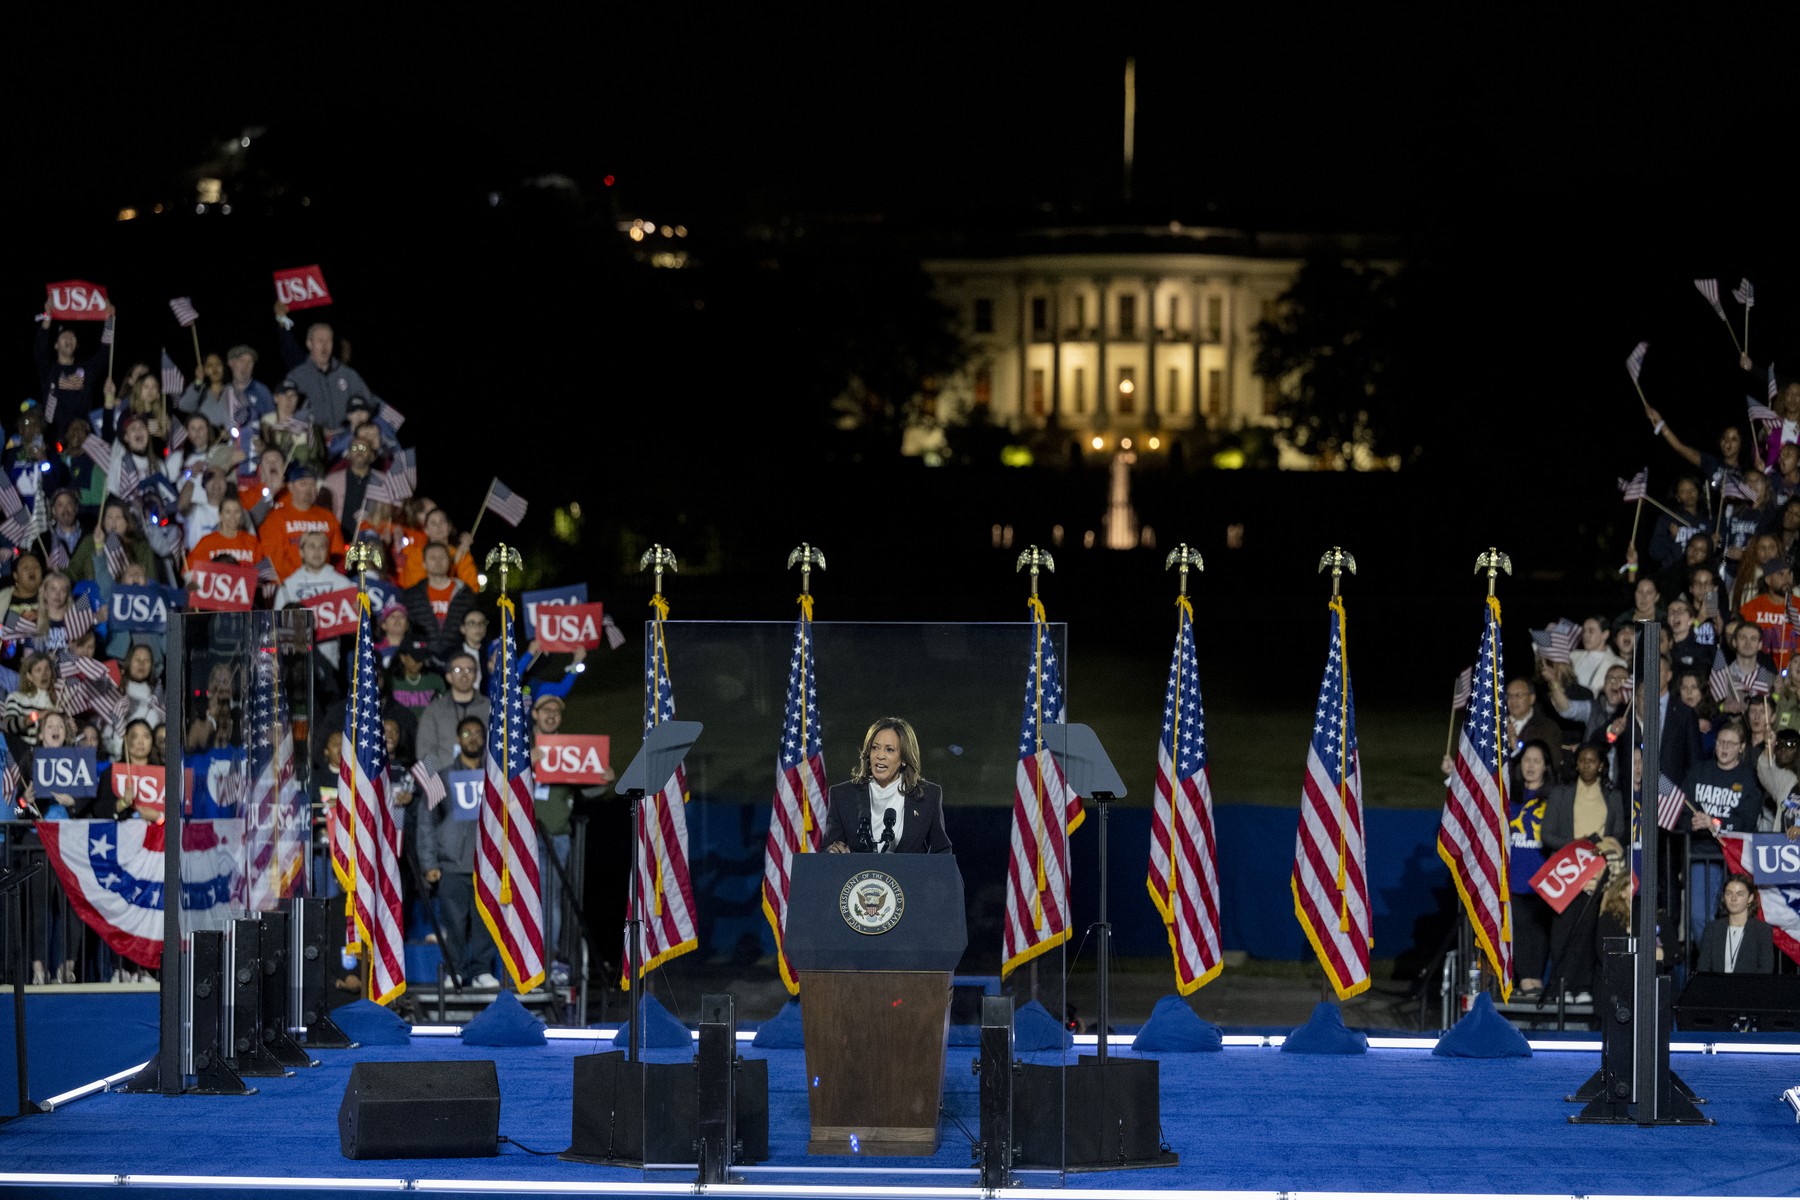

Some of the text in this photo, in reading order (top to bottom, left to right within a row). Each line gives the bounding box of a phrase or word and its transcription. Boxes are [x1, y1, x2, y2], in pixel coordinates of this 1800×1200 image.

[51, 287, 107, 312] USA
[275, 275, 328, 304] USA
[197, 570, 249, 604] USA
[112, 593, 167, 622] USA
[540, 613, 599, 642] USA
[36, 758, 94, 787] USA
[540, 745, 605, 773] USA
[1695, 783, 1742, 808] HARRIS
[1537, 847, 1596, 898] USA
[1756, 844, 1800, 873] US
[842, 876, 859, 914] PRESIDENT
[885, 876, 903, 904] UNITED
[882, 907, 902, 931] STATES
